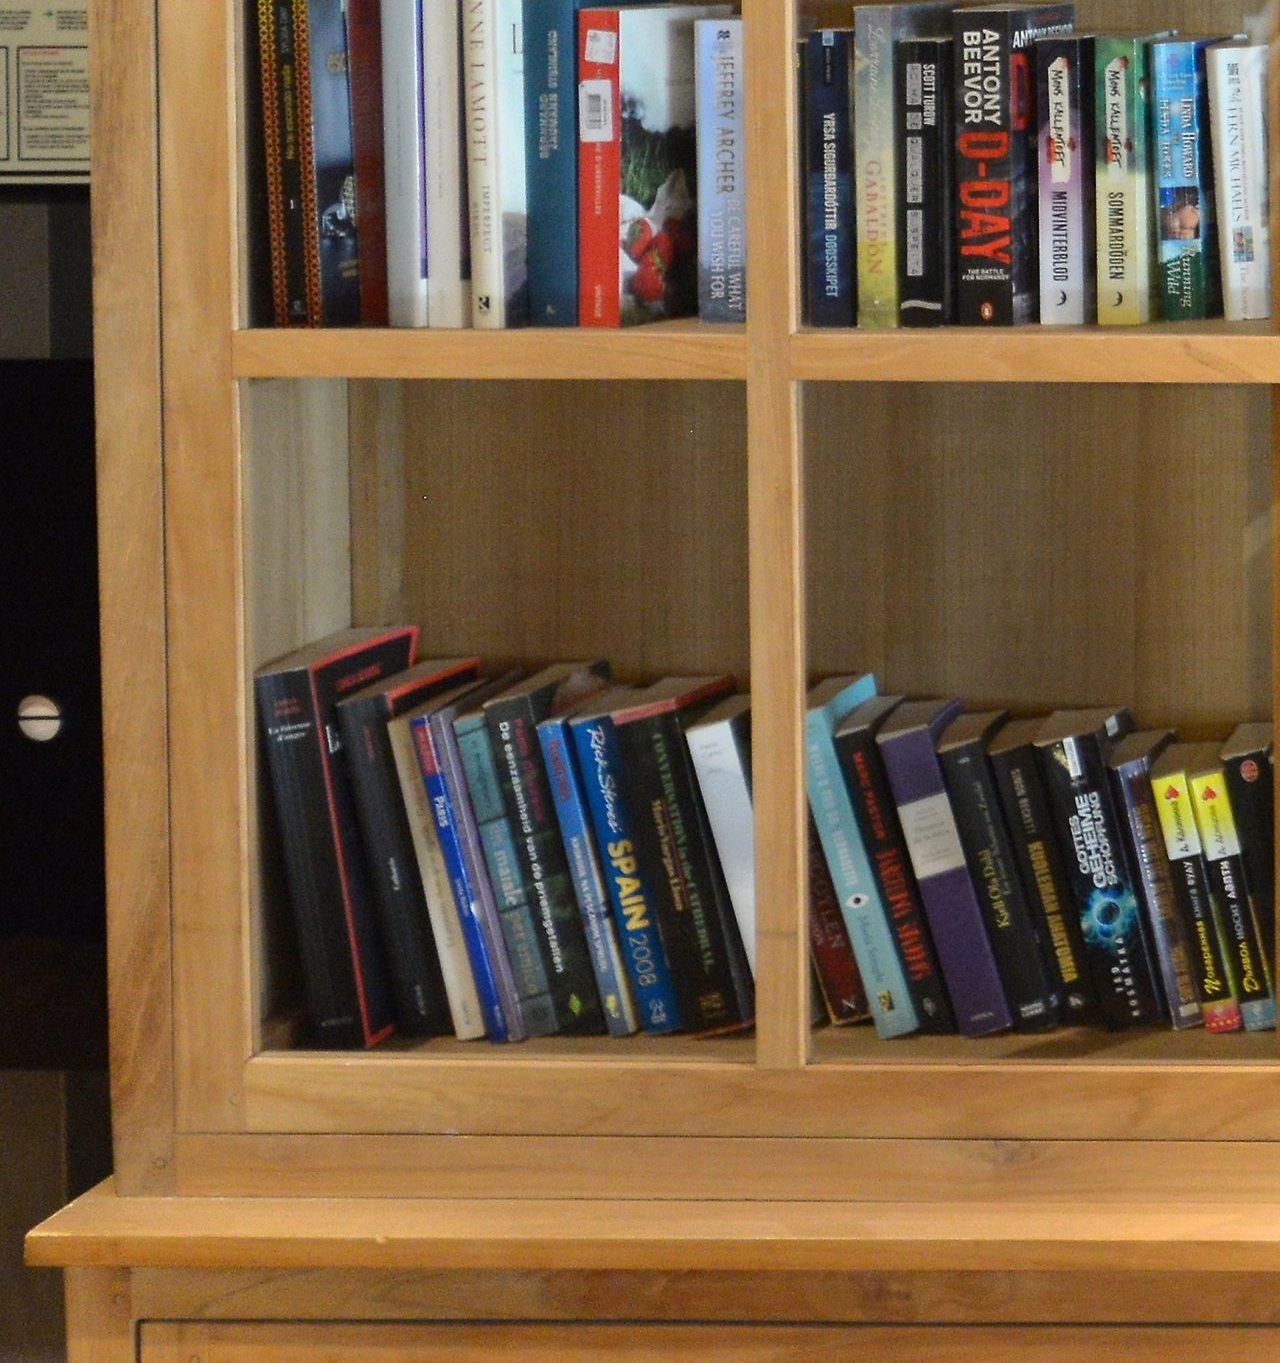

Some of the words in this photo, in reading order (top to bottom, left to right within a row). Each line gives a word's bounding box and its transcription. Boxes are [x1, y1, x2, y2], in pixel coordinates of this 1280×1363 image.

[716, 56, 735, 120] JEFFREY
[922, 64, 935, 91] SCOTT
[962, 31, 983, 124] BEEVOR
[982, 29, 1000, 125] ANTONY
[471, 62, 488, 166] LAMOTT
[823, 113, 835, 143] YRSA
[923, 93, 935, 126] TUROW
[716, 127, 736, 195] ARCHER
[1181, 133, 1194, 179] HOWARD
[711, 212, 723, 237] YOU
[865, 160, 883, 274] GABALDON
[959, 131, 1012, 264] D-DAY
[710, 239, 722, 273] WISH
[728, 215, 740, 269] CAREFUL
[1052, 191, 1068, 281] MIDVINTERBLOD
[1108, 192, 1127, 280] SOMMARDÖDEN
[709, 275, 721, 300] FOR
[728, 272, 740, 310] WHAT
[1167, 259, 1180, 295] Wild
[1182, 246, 1194, 308] Running
[588, 726, 609, 769] Rick
[433, 796, 450, 828] PARIS
[526, 838, 539, 860] van
[1069, 816, 1088, 875] GOTTES
[1075, 793, 1107, 888] GEHEIME
[531, 862, 542, 879] de
[1027, 841, 1058, 913] KUOLEMAN
[608, 840, 649, 931] SPAIN
[629, 933, 657, 987] 2008
